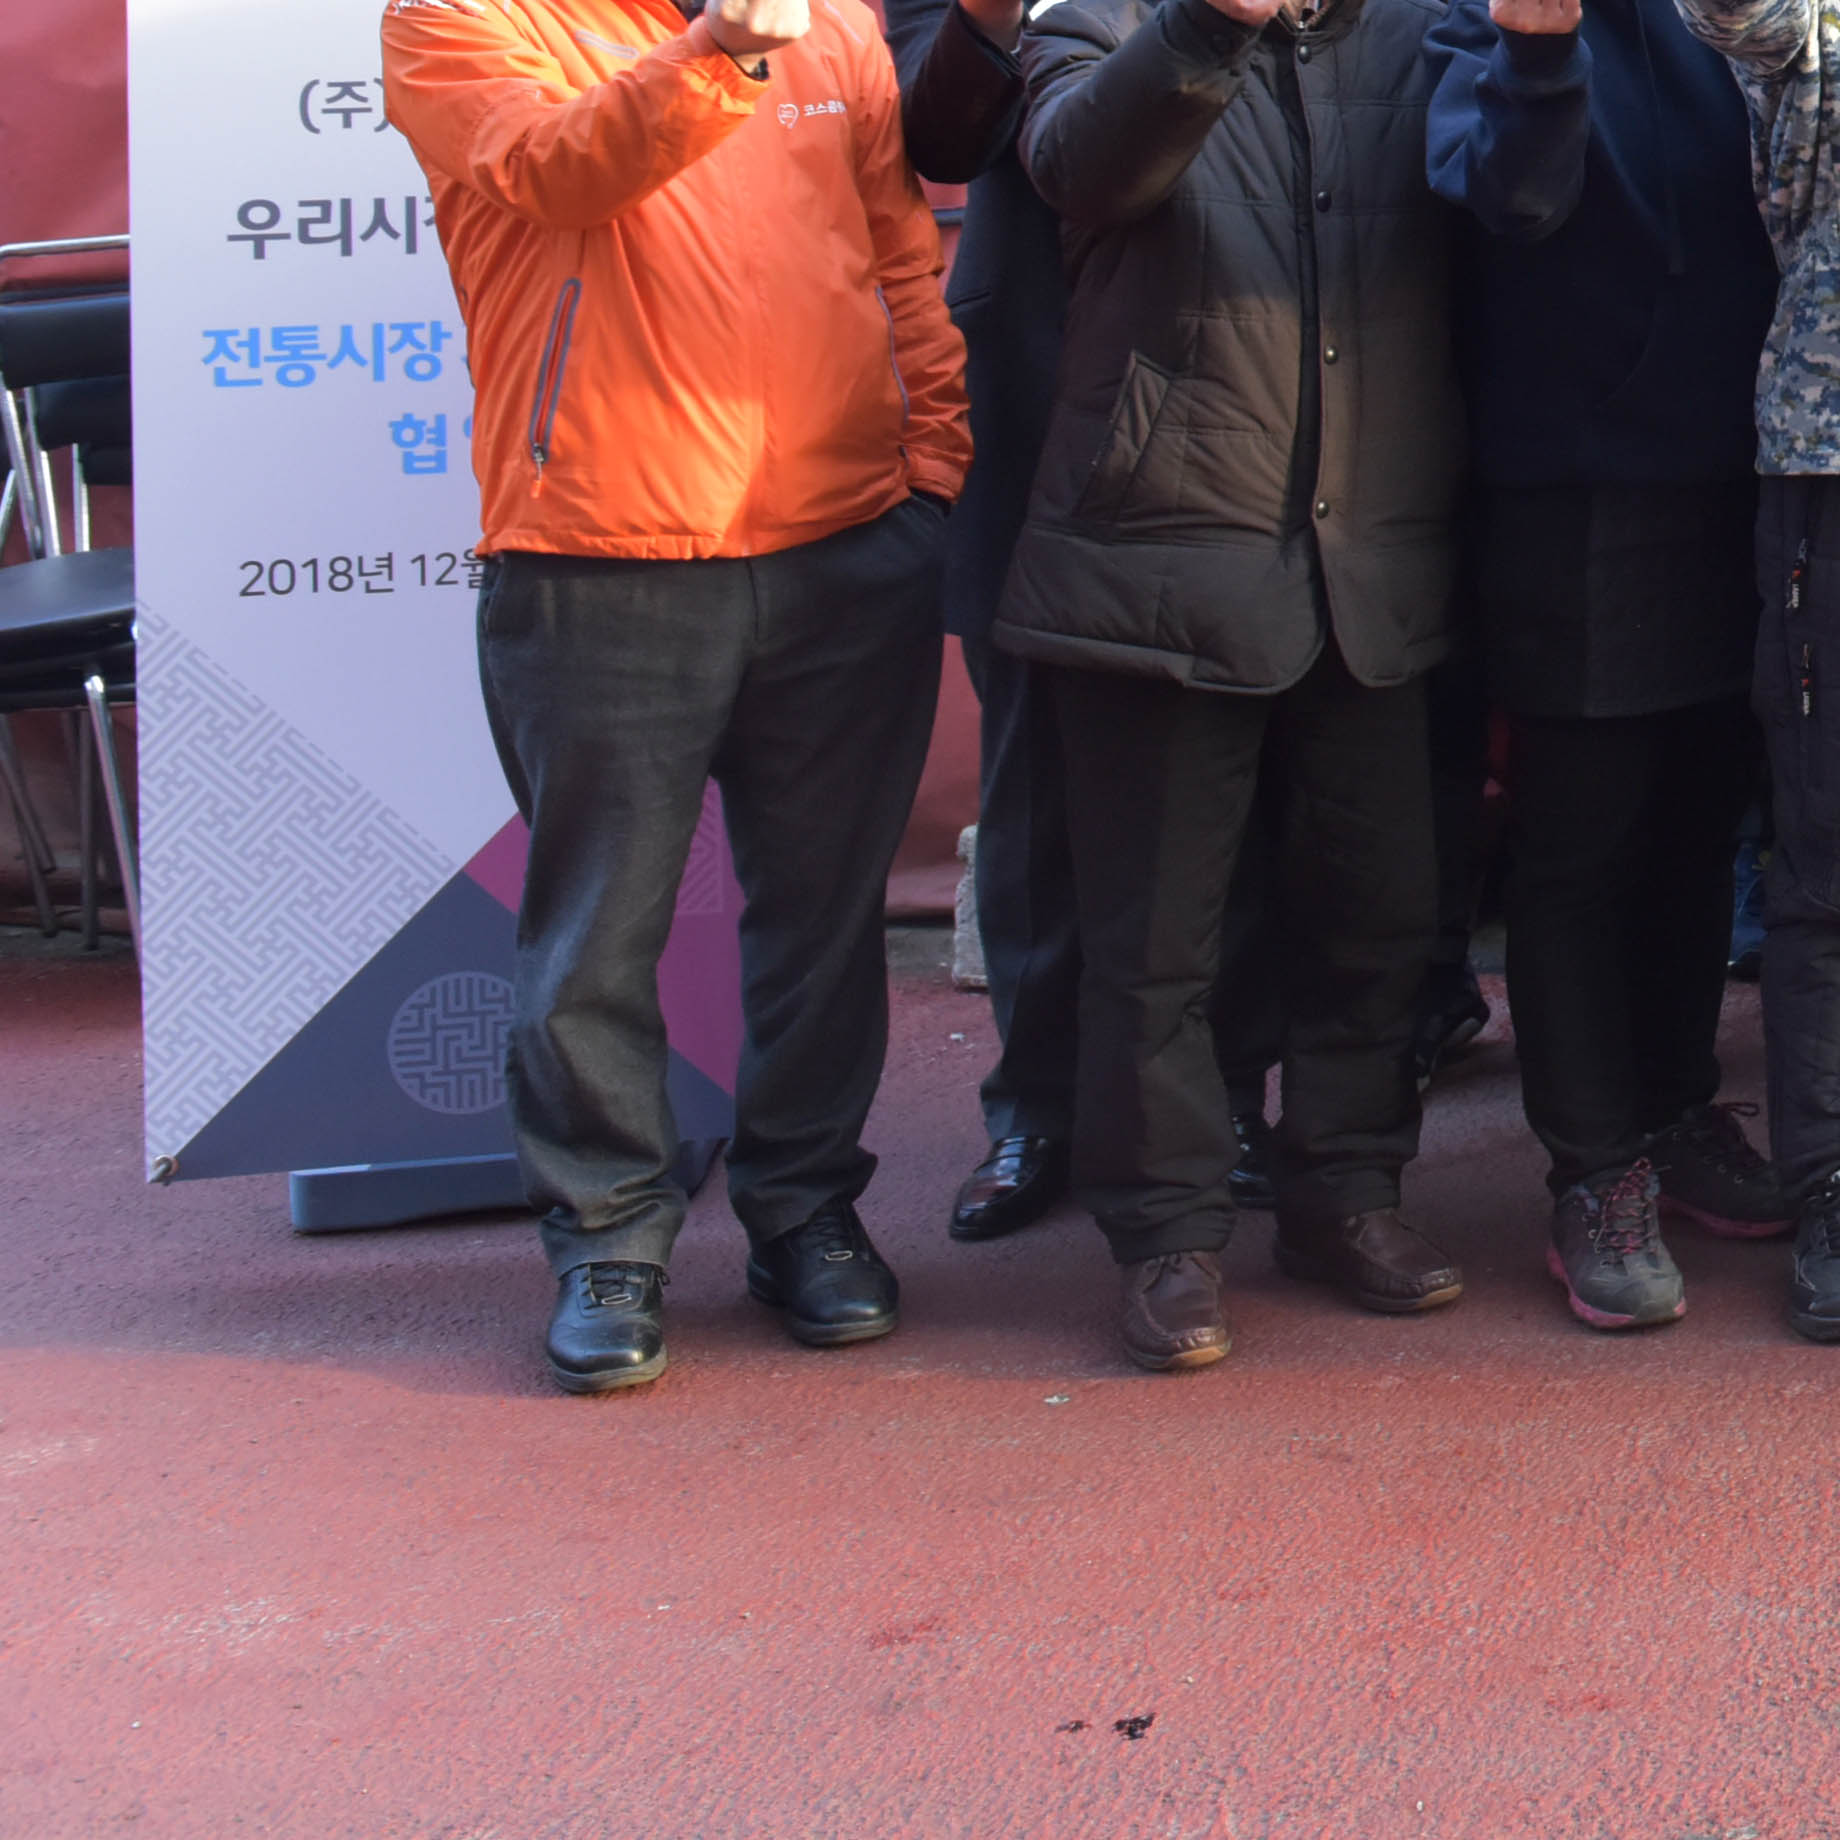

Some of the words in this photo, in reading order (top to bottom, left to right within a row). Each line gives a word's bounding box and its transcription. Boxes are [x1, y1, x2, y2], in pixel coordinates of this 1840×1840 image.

[226, 195, 436, 261] 우리시
[200, 320, 453, 389] 전통시장
[238, 551, 395, 598] 2018년
